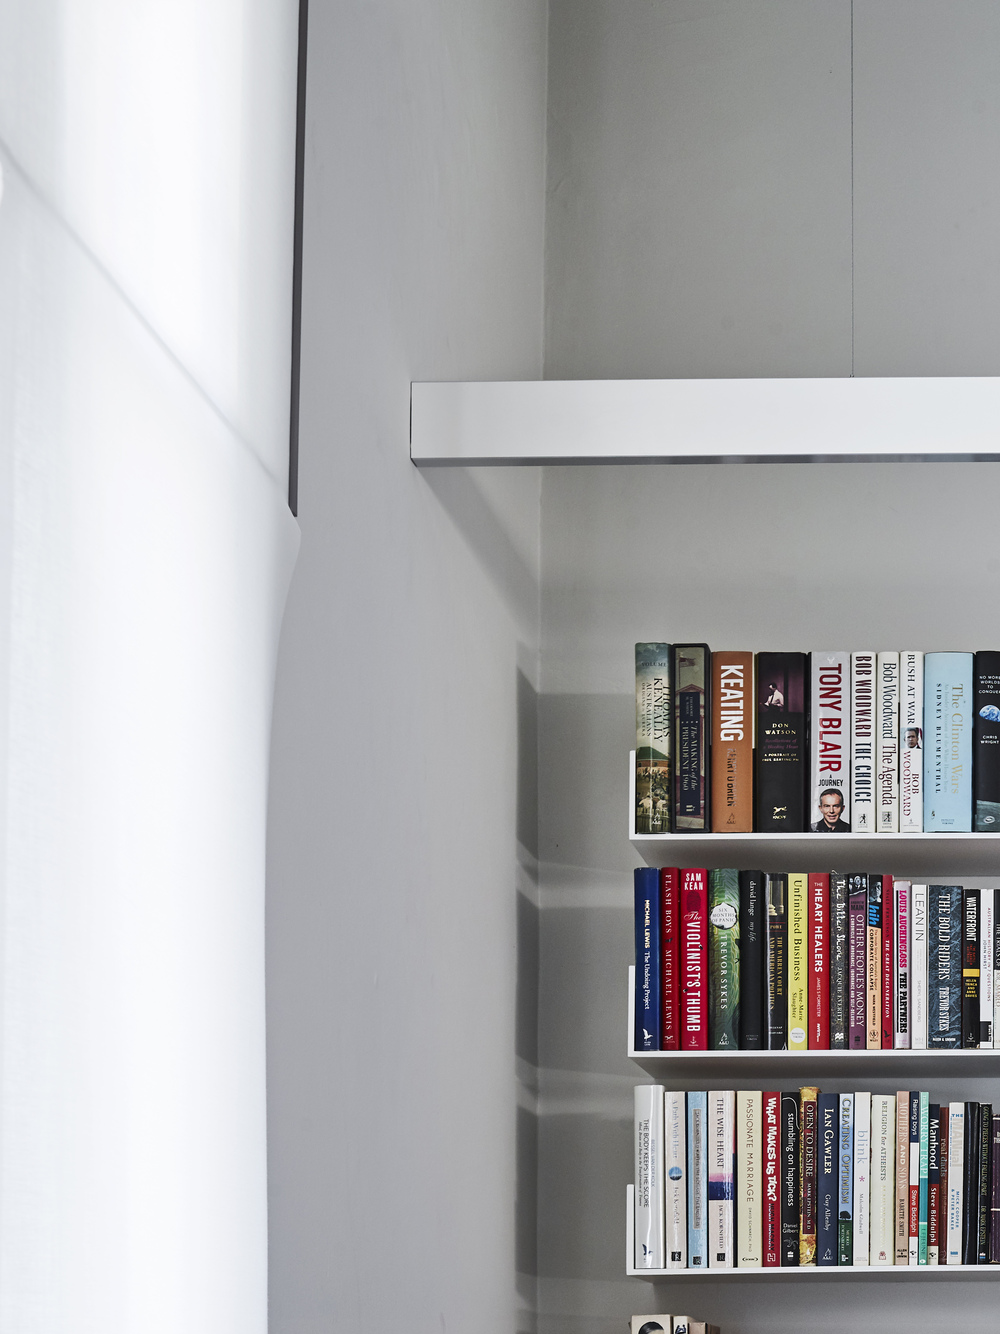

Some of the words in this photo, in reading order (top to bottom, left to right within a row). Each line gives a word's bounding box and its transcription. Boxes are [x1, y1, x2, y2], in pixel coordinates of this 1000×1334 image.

[855, 656, 871, 675] BOB
[882, 663, 896, 682] Bob
[907, 654, 915, 681] BUSH
[720, 665, 743, 741] KEATING
[820, 663, 841, 711] TONY
[907, 685, 915, 699] AT
[951, 684, 963, 708] The
[855, 679, 871, 737] WOODWARD
[882, 684, 896, 739] Woodward
[907, 700, 915, 724] WAR
[820, 718, 841, 772] BLAIR
[855, 742, 871, 760] THE
[951, 713, 963, 760] Clinton
[882, 744, 896, 764] The
[855, 765, 871, 803] CHOICE
[878, 766, 896, 805] Agenda
[903, 751, 911, 816] WOODWARD
[951, 765, 963, 794] Wars
[684, 882, 703, 890] KEAN
[686, 873, 701, 881] SAM
[794, 880, 802, 934] Unfinished
[869, 905, 879, 926] hih
[899, 890, 907, 913] LOUIS
[915, 893, 924, 925] LEAN
[939, 894, 950, 914] THE
[748, 922, 754, 930] my
[856, 914, 864, 947] OTHER
[939, 917, 950, 941] BOLD
[966, 897, 976, 941] WATERFRONT
[899, 915, 907, 968] AUCHINCLOSS
[915, 930, 923, 941] IN
[687, 922, 701, 987] VIOLINIST'S
[794, 939, 802, 981] Business
[856, 950, 864, 989] PEOPLE'S
[939, 945, 950, 980] RIDERS
[687, 991, 700, 1031] THUMB
[939, 987, 949, 1010] TREVOR
[939, 1012, 949, 1031] SYKES
[766, 1098, 776, 1124] WHAT
[825, 1109, 833, 1126] IAN
[768, 1126, 777, 1160] MAKES
[786, 1113, 795, 1151] stumbling
[857, 1130, 868, 1164] blink
[929, 1119, 939, 1169] Manhood
[766, 1162, 775, 1174] US
[824, 1130, 833, 1174] GAWLER
[768, 1176, 777, 1201] TICK?
[786, 1168, 794, 1206] happiness
